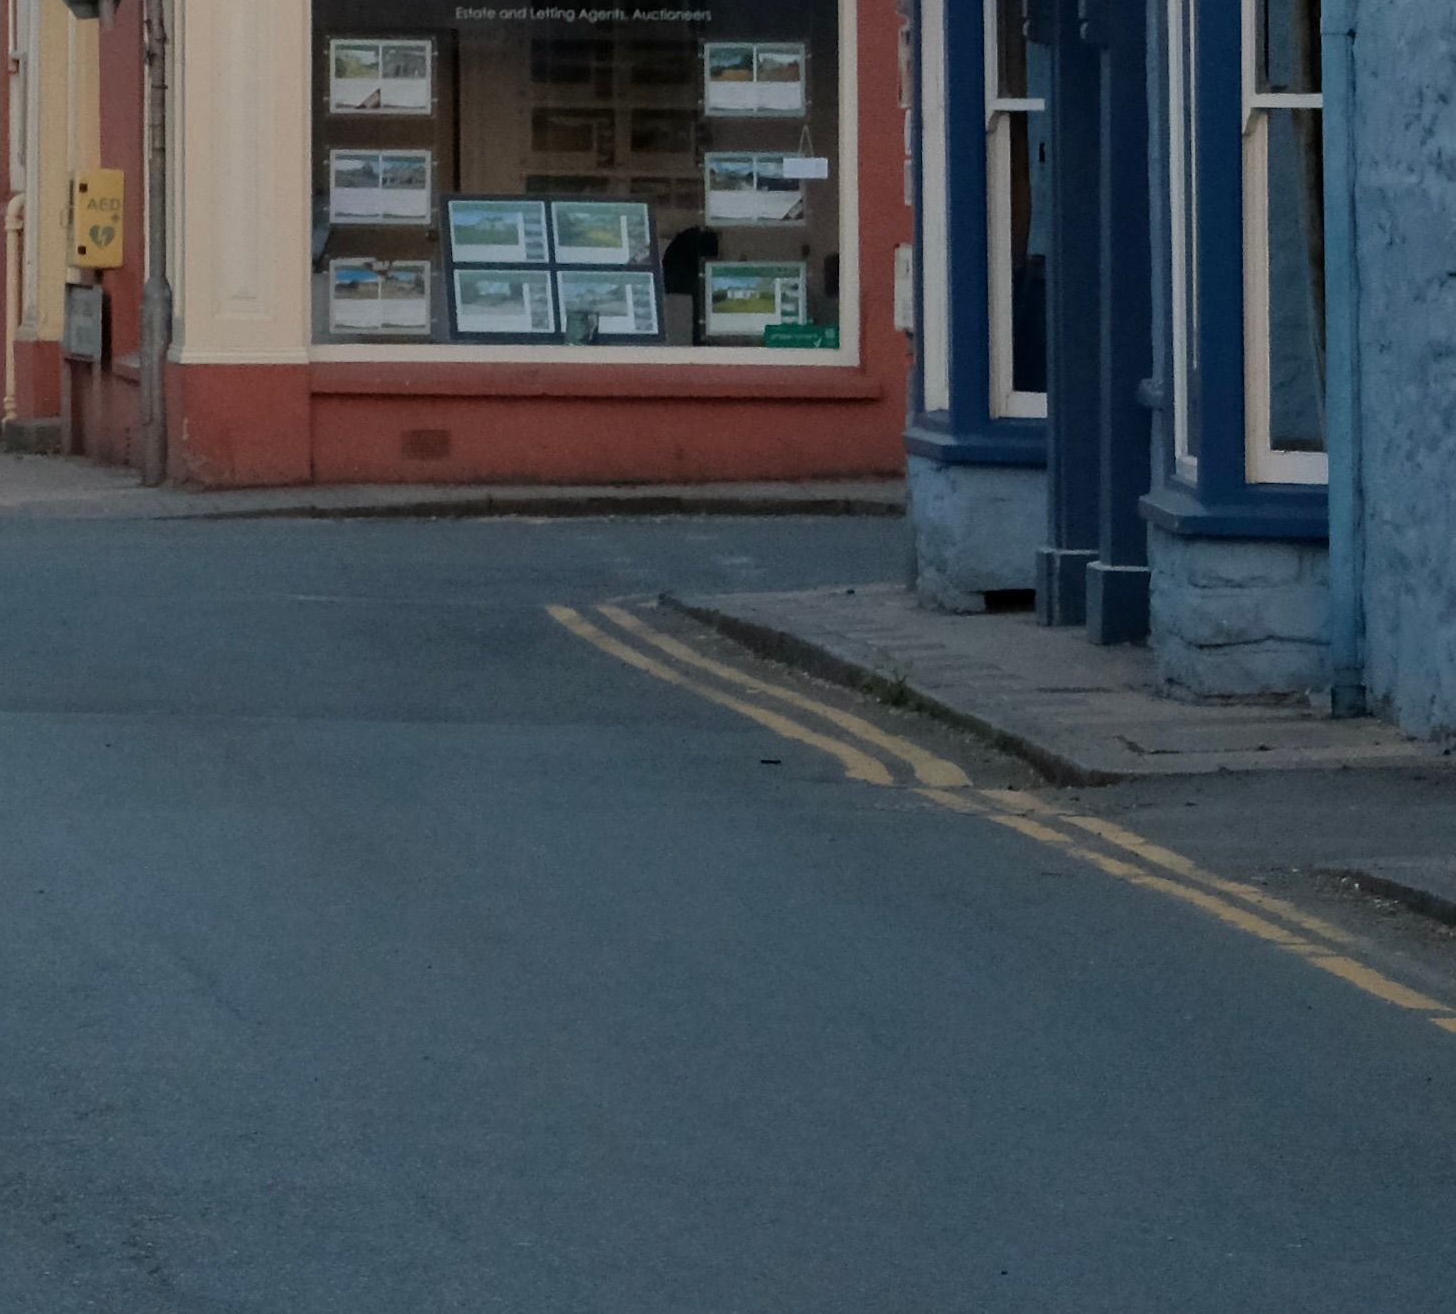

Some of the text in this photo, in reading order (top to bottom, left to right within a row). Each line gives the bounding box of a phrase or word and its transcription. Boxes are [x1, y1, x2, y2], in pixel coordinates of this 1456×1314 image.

[456, 7, 496, 20] Estate
[499, 7, 527, 20] and
[530, 7, 575, 22] Letting
[632, 8, 713, 22] Auctioneers
[87, 198, 121, 211] AED
